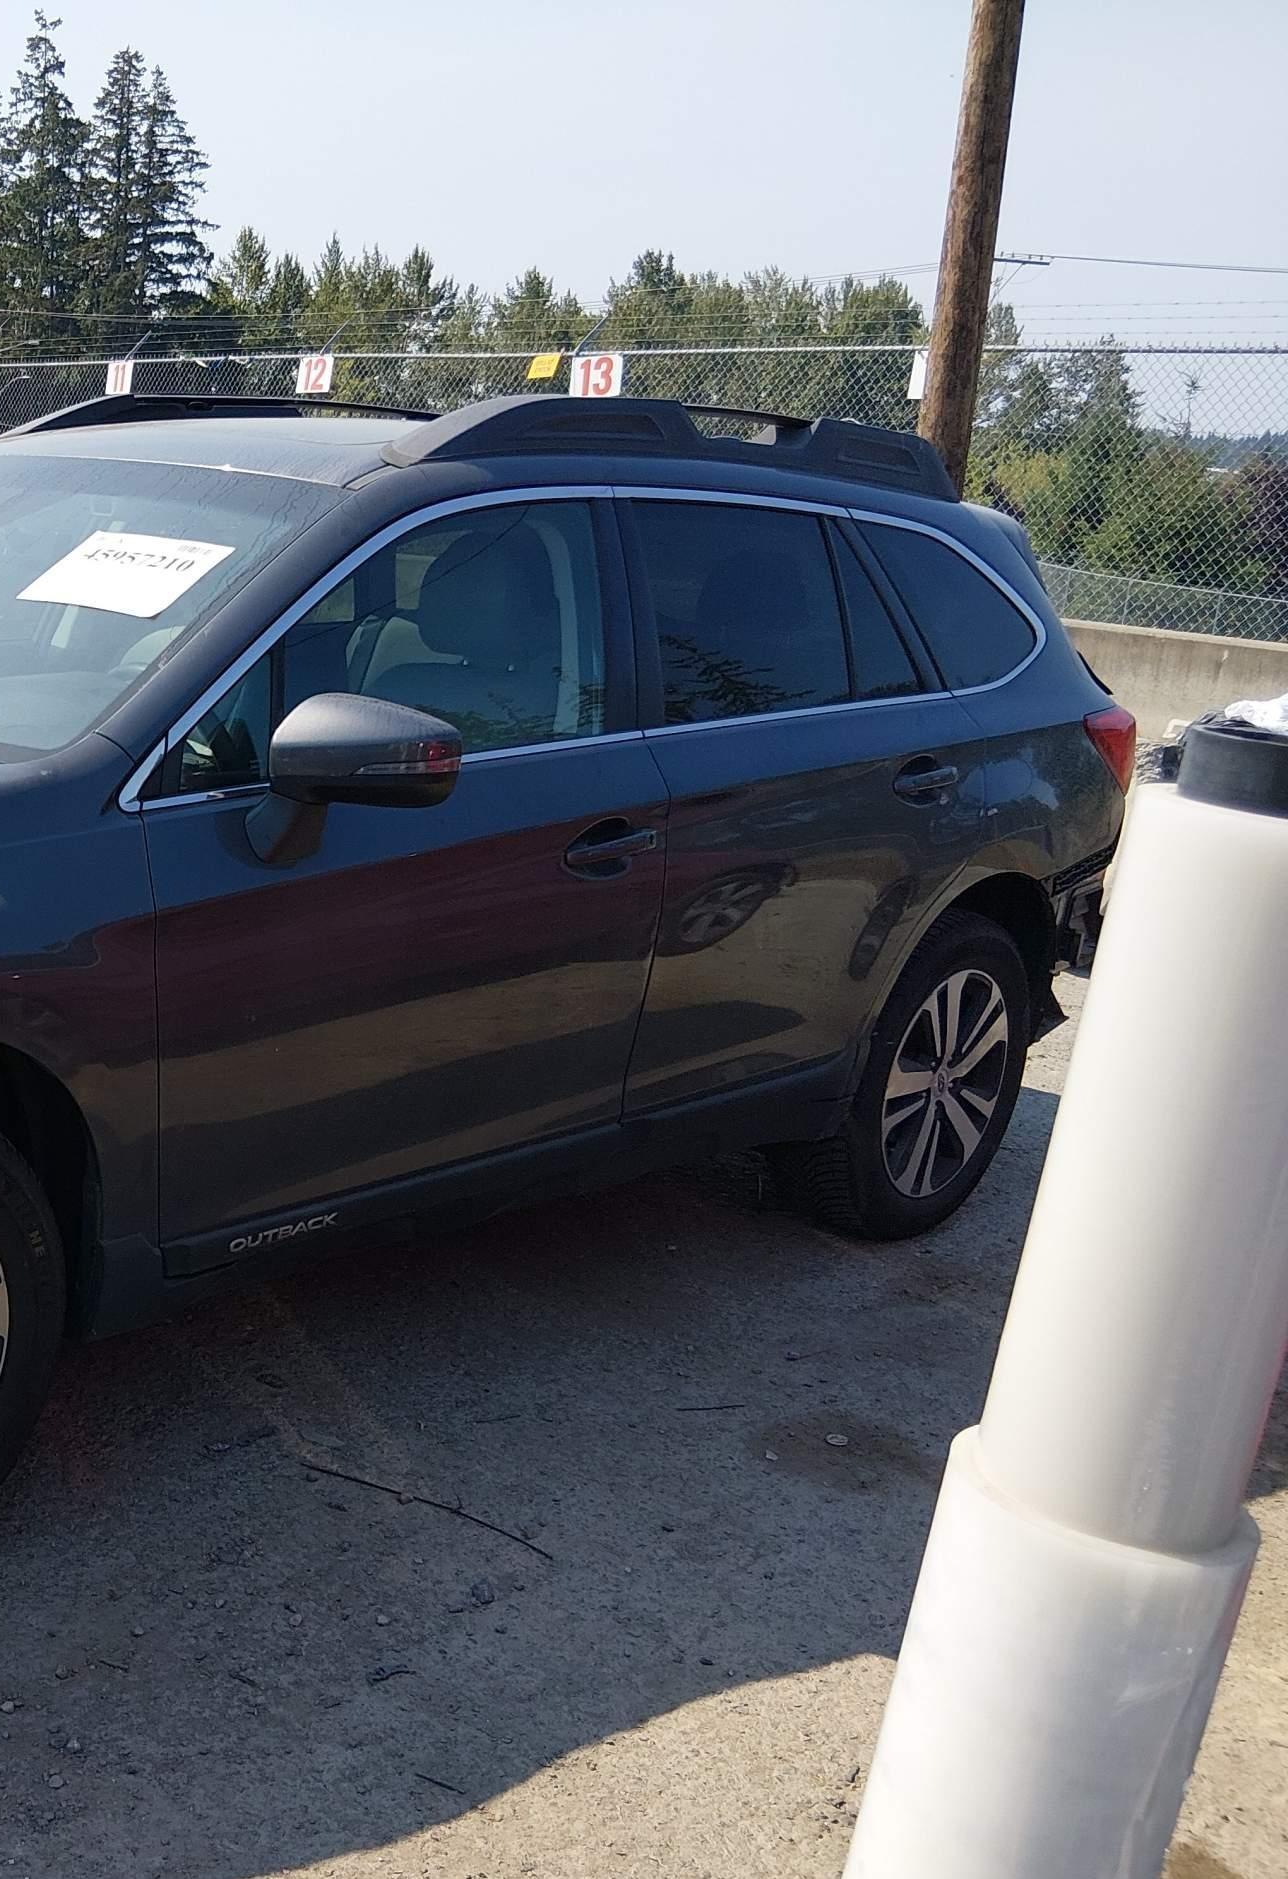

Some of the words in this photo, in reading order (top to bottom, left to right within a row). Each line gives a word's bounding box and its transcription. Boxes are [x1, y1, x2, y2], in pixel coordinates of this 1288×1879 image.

[113, 364, 127, 393] 11
[304, 358, 326, 391] 12
[580, 356, 614, 396] 13
[229, 1211, 339, 1253] OUTBACK
